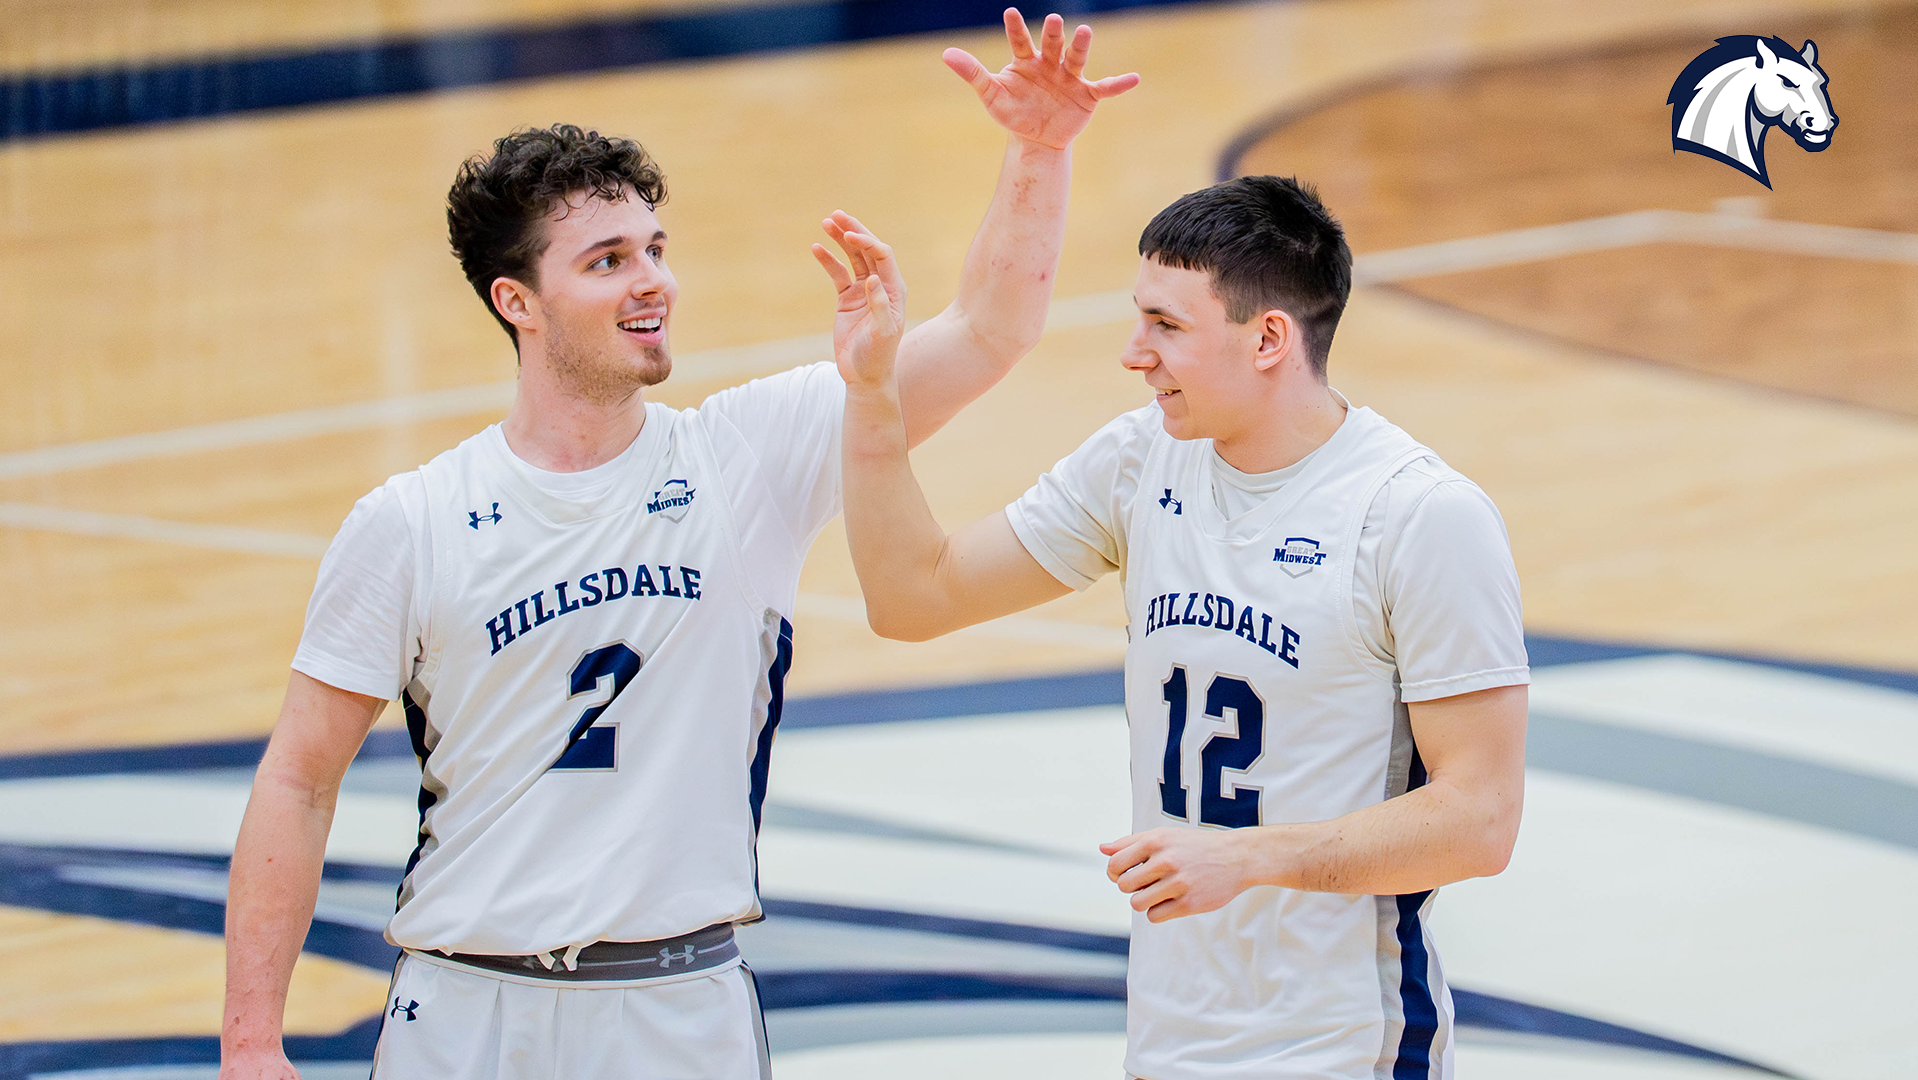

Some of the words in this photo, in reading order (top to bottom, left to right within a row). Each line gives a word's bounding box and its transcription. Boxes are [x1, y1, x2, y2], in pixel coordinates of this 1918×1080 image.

[647, 488, 696, 514] MIDWEST
[1273, 548, 1327, 565] MIDWEST
[1287, 546, 1315, 555] GREAT
[485, 564, 702, 657] HILLSDALE
[1145, 592, 1300, 670] HILLSDALE
[545, 638, 645, 773] 2
[1157, 662, 1266, 830] 12
